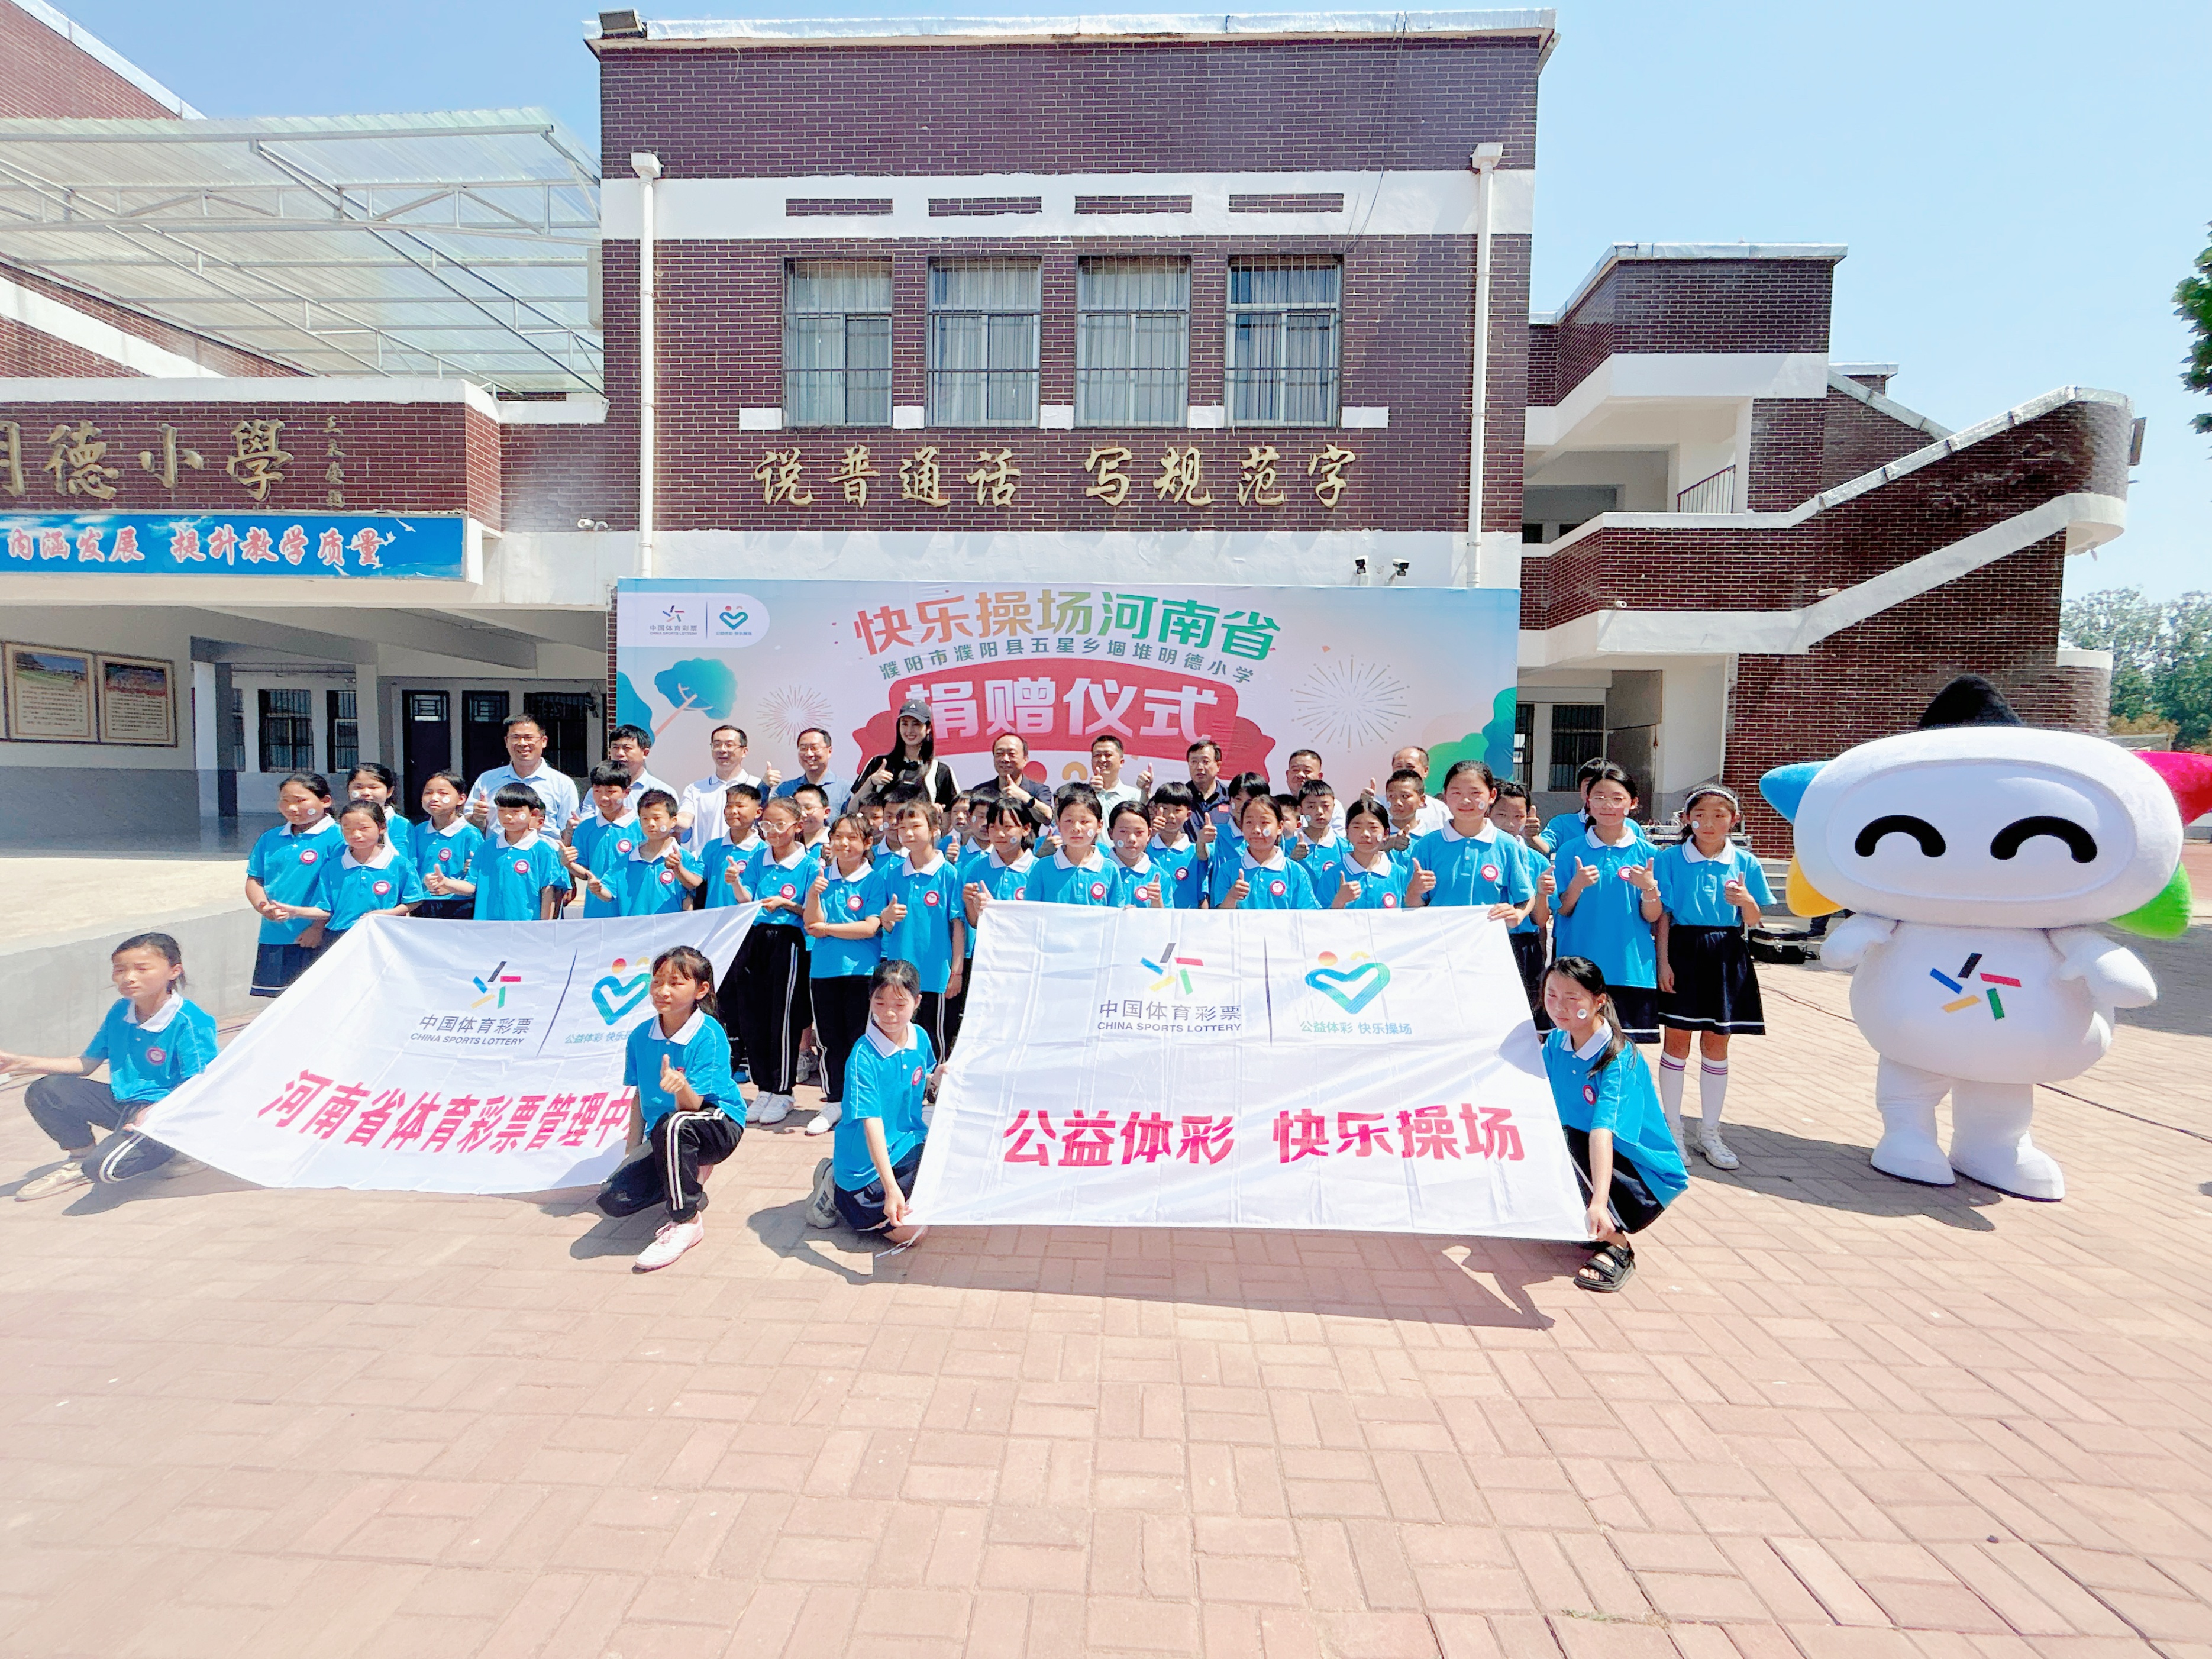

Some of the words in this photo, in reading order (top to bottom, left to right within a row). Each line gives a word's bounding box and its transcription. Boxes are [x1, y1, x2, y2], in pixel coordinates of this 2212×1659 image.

[753, 444, 1022, 508] 说普通话
[1084, 444, 1355, 508] 写规范字
[8, 526, 144, 562] 内涵发展
[170, 524, 382, 565] 提升教学质量
[854, 589, 1281, 661] 快乐操场河南省
[879, 637, 1254, 683] 濮阳市濮阳县五星乡堌堆明德小学
[905, 677, 1218, 745] 捐赠仪式
[419, 1014, 534, 1034] 中国体育彩票
[1097, 1022, 1133, 1030] CHINA
[1136, 1022, 1184, 1032] SPORTS
[1187, 1024, 1241, 1032] LOTTERY
[1099, 999, 1242, 1022] 中国体育彩票
[1300, 1020, 1354, 1034] 公益体彩
[1358, 1022, 1412, 1035] 快乐操场
[411, 1033, 440, 1042] CHINA
[442, 1035, 480, 1045] SPORTS
[482, 1037, 525, 1045] LOTTERY
[564, 1032, 604, 1044] 公益体彩
[257, 1069, 632, 1154] 河南省体育彩票管理中
[1002, 1108, 1235, 1167] 公益体彩
[1273, 1103, 1525, 1163] 快乐操场
